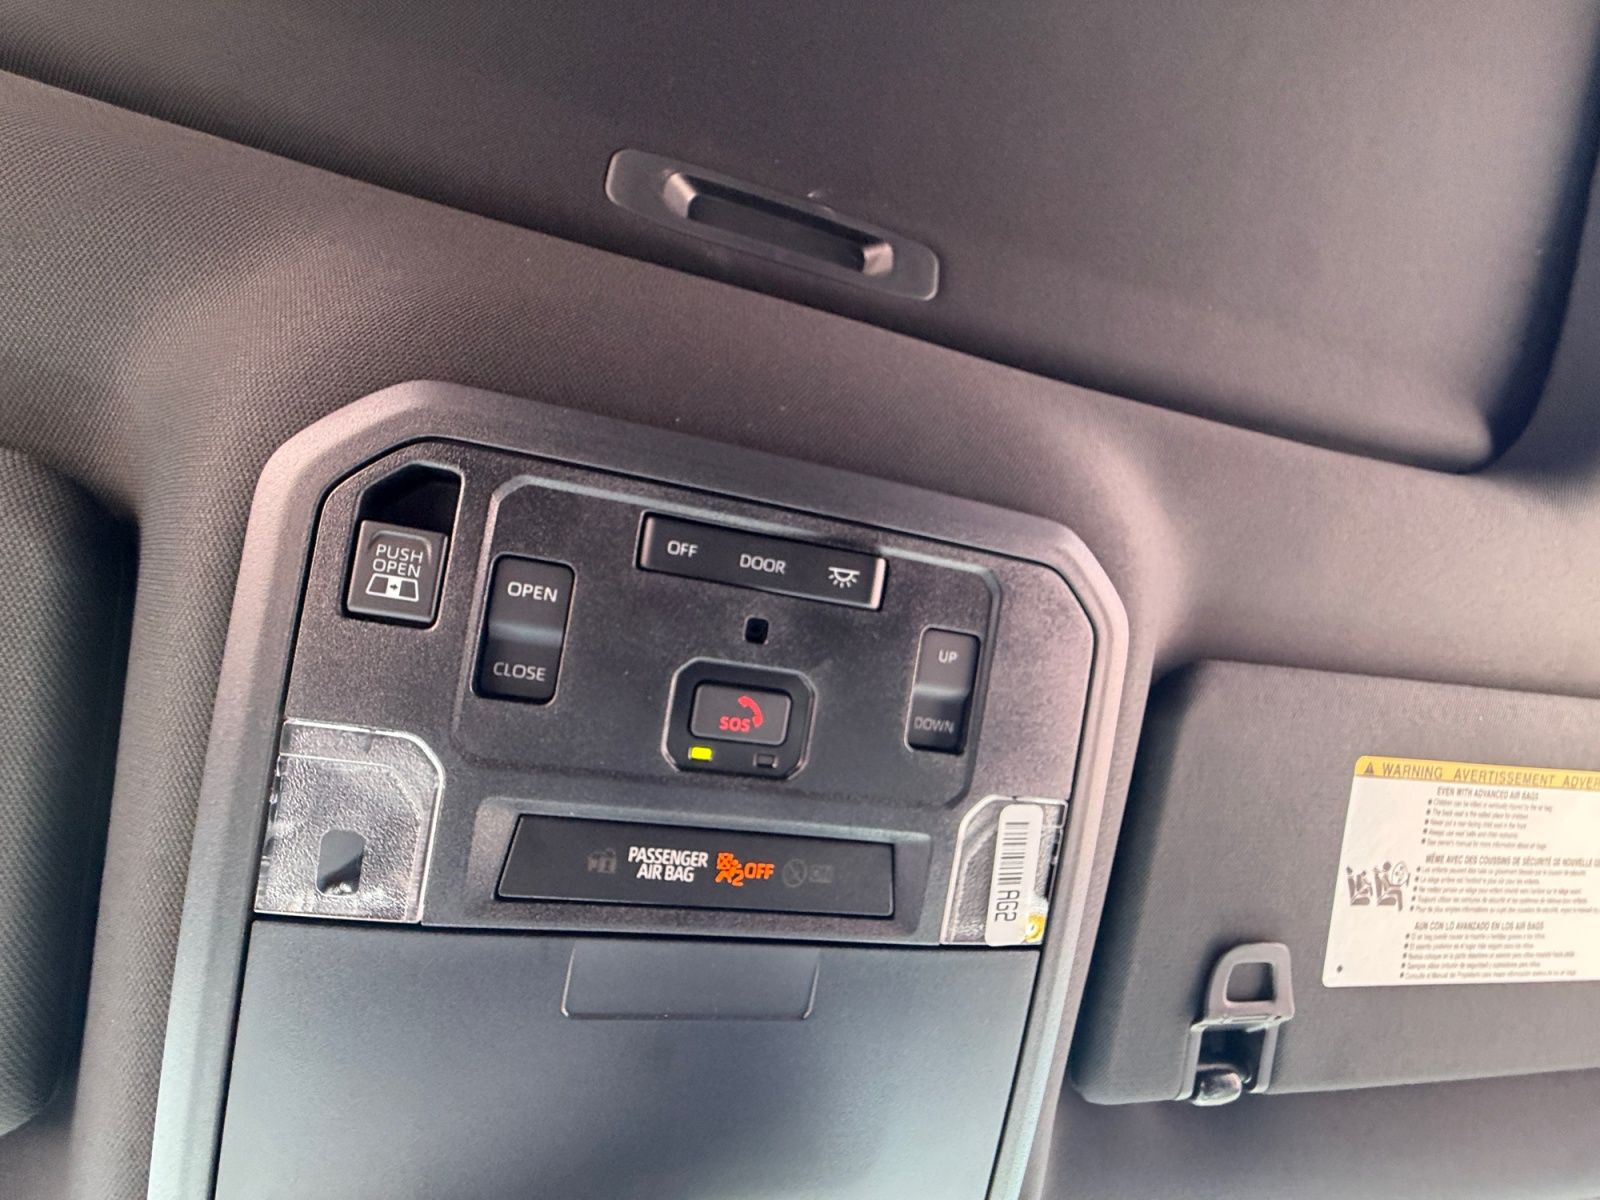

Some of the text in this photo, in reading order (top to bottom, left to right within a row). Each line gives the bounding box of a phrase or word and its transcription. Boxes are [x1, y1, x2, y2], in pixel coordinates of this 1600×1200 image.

[375, 543, 424, 564] PUSH
[666, 540, 699, 559] OFF
[372, 558, 422, 578] OPEN
[739, 553, 787, 575] DOOR
[506, 581, 559, 603] OPEN
[937, 649, 959, 664] UP
[492, 661, 547, 682] CLOSE
[719, 715, 751, 733] SOS
[913, 716, 955, 735] DOWN
[1382, 762, 1443, 779] WARNING
[1454, 768, 1556, 786] AVERTISSEMENT
[628, 846, 709, 868] PASSENGER
[636, 863, 695, 883] AIR BAG
[744, 862, 775, 880] OFF
[994, 889, 1020, 923] AG2
